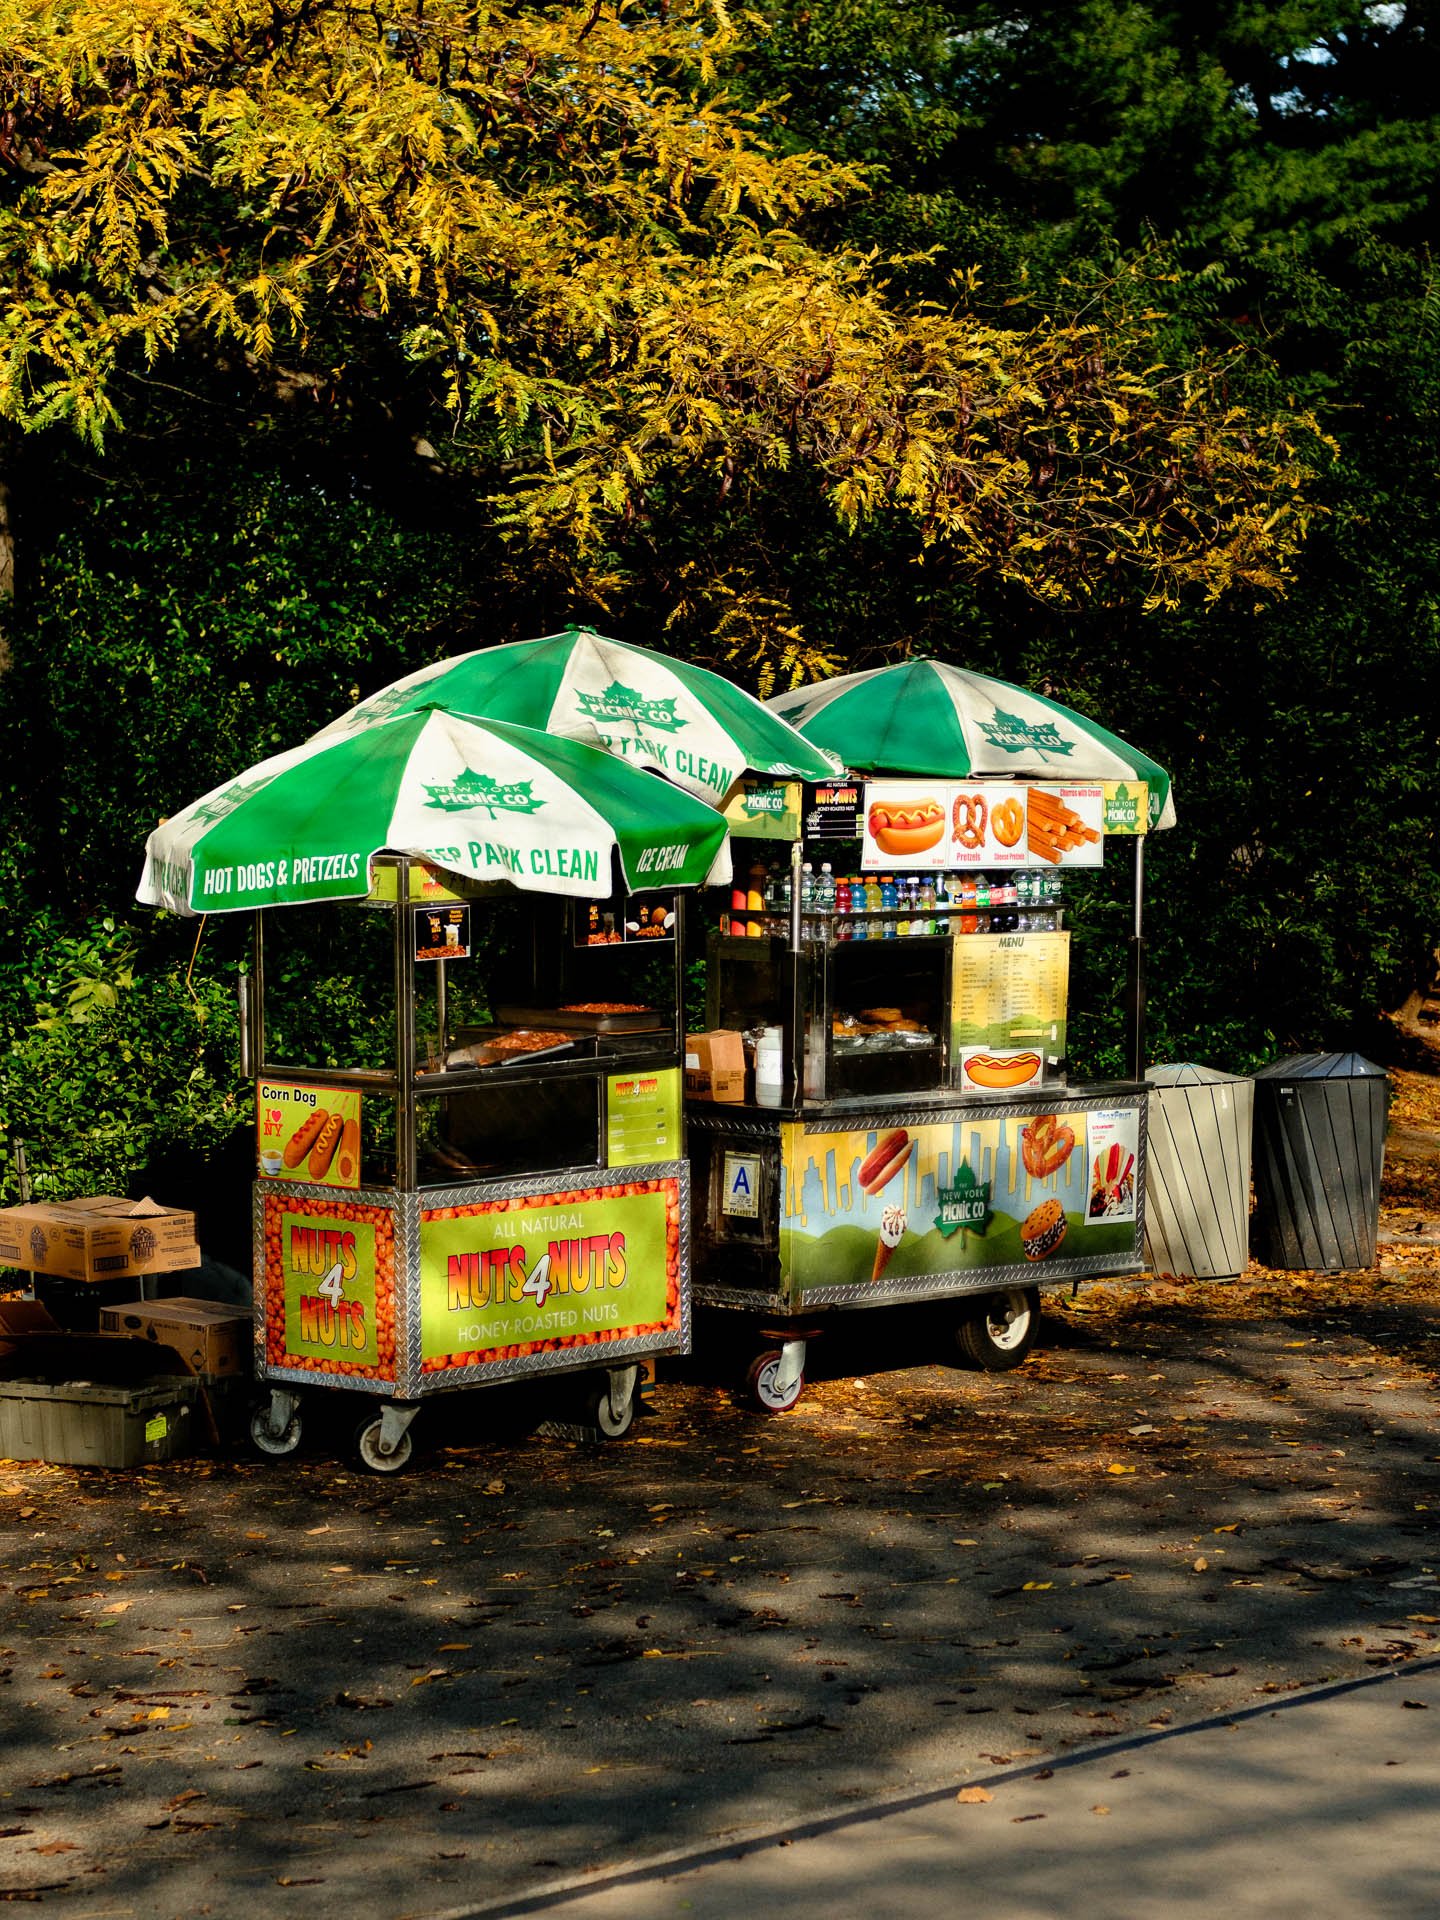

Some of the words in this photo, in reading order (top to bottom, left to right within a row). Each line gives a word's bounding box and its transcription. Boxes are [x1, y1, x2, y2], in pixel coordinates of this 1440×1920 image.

[584, 695, 620, 705] NEW
[627, 700, 667, 709] YORK
[648, 710, 672, 722] CO
[983, 724, 1012, 732] NEW
[1040, 735, 1062, 746] CO
[676, 750, 733, 796] CLEAN
[502, 794, 529, 805] CO
[772, 797, 783, 809] CO
[426, 847, 462, 863] EEP
[468, 841, 524, 874] PARK
[530, 849, 598, 881] CLEAN
[636, 848, 658, 872] ICE
[655, 844, 689, 871] CREAM
[956, 852, 981, 861] Pretzels
[203, 867, 233, 894] HOT
[237, 862, 275, 892] DOGS
[276, 860, 288, 885] &
[292, 853, 361, 885] PRETZELS
[999, 937, 1024, 948] MENU
[262, 1086, 289, 1101] Corn
[293, 1089, 317, 1106] Dog
[263, 1122, 283, 1136] NY
[732, 1166, 750, 1194] A
[943, 1191, 960, 1200] NEW
[964, 1189, 984, 1198] YORK
[972, 1202, 985, 1218] CO
[494, 1222, 516, 1239] ALL
[521, 1213, 584, 1234] NATURAL
[291, 1225, 359, 1281] NUTS
[318, 1263, 345, 1310] 4
[583, 1304, 618, 1321] NUTS
[300, 1295, 367, 1351] NUTS
